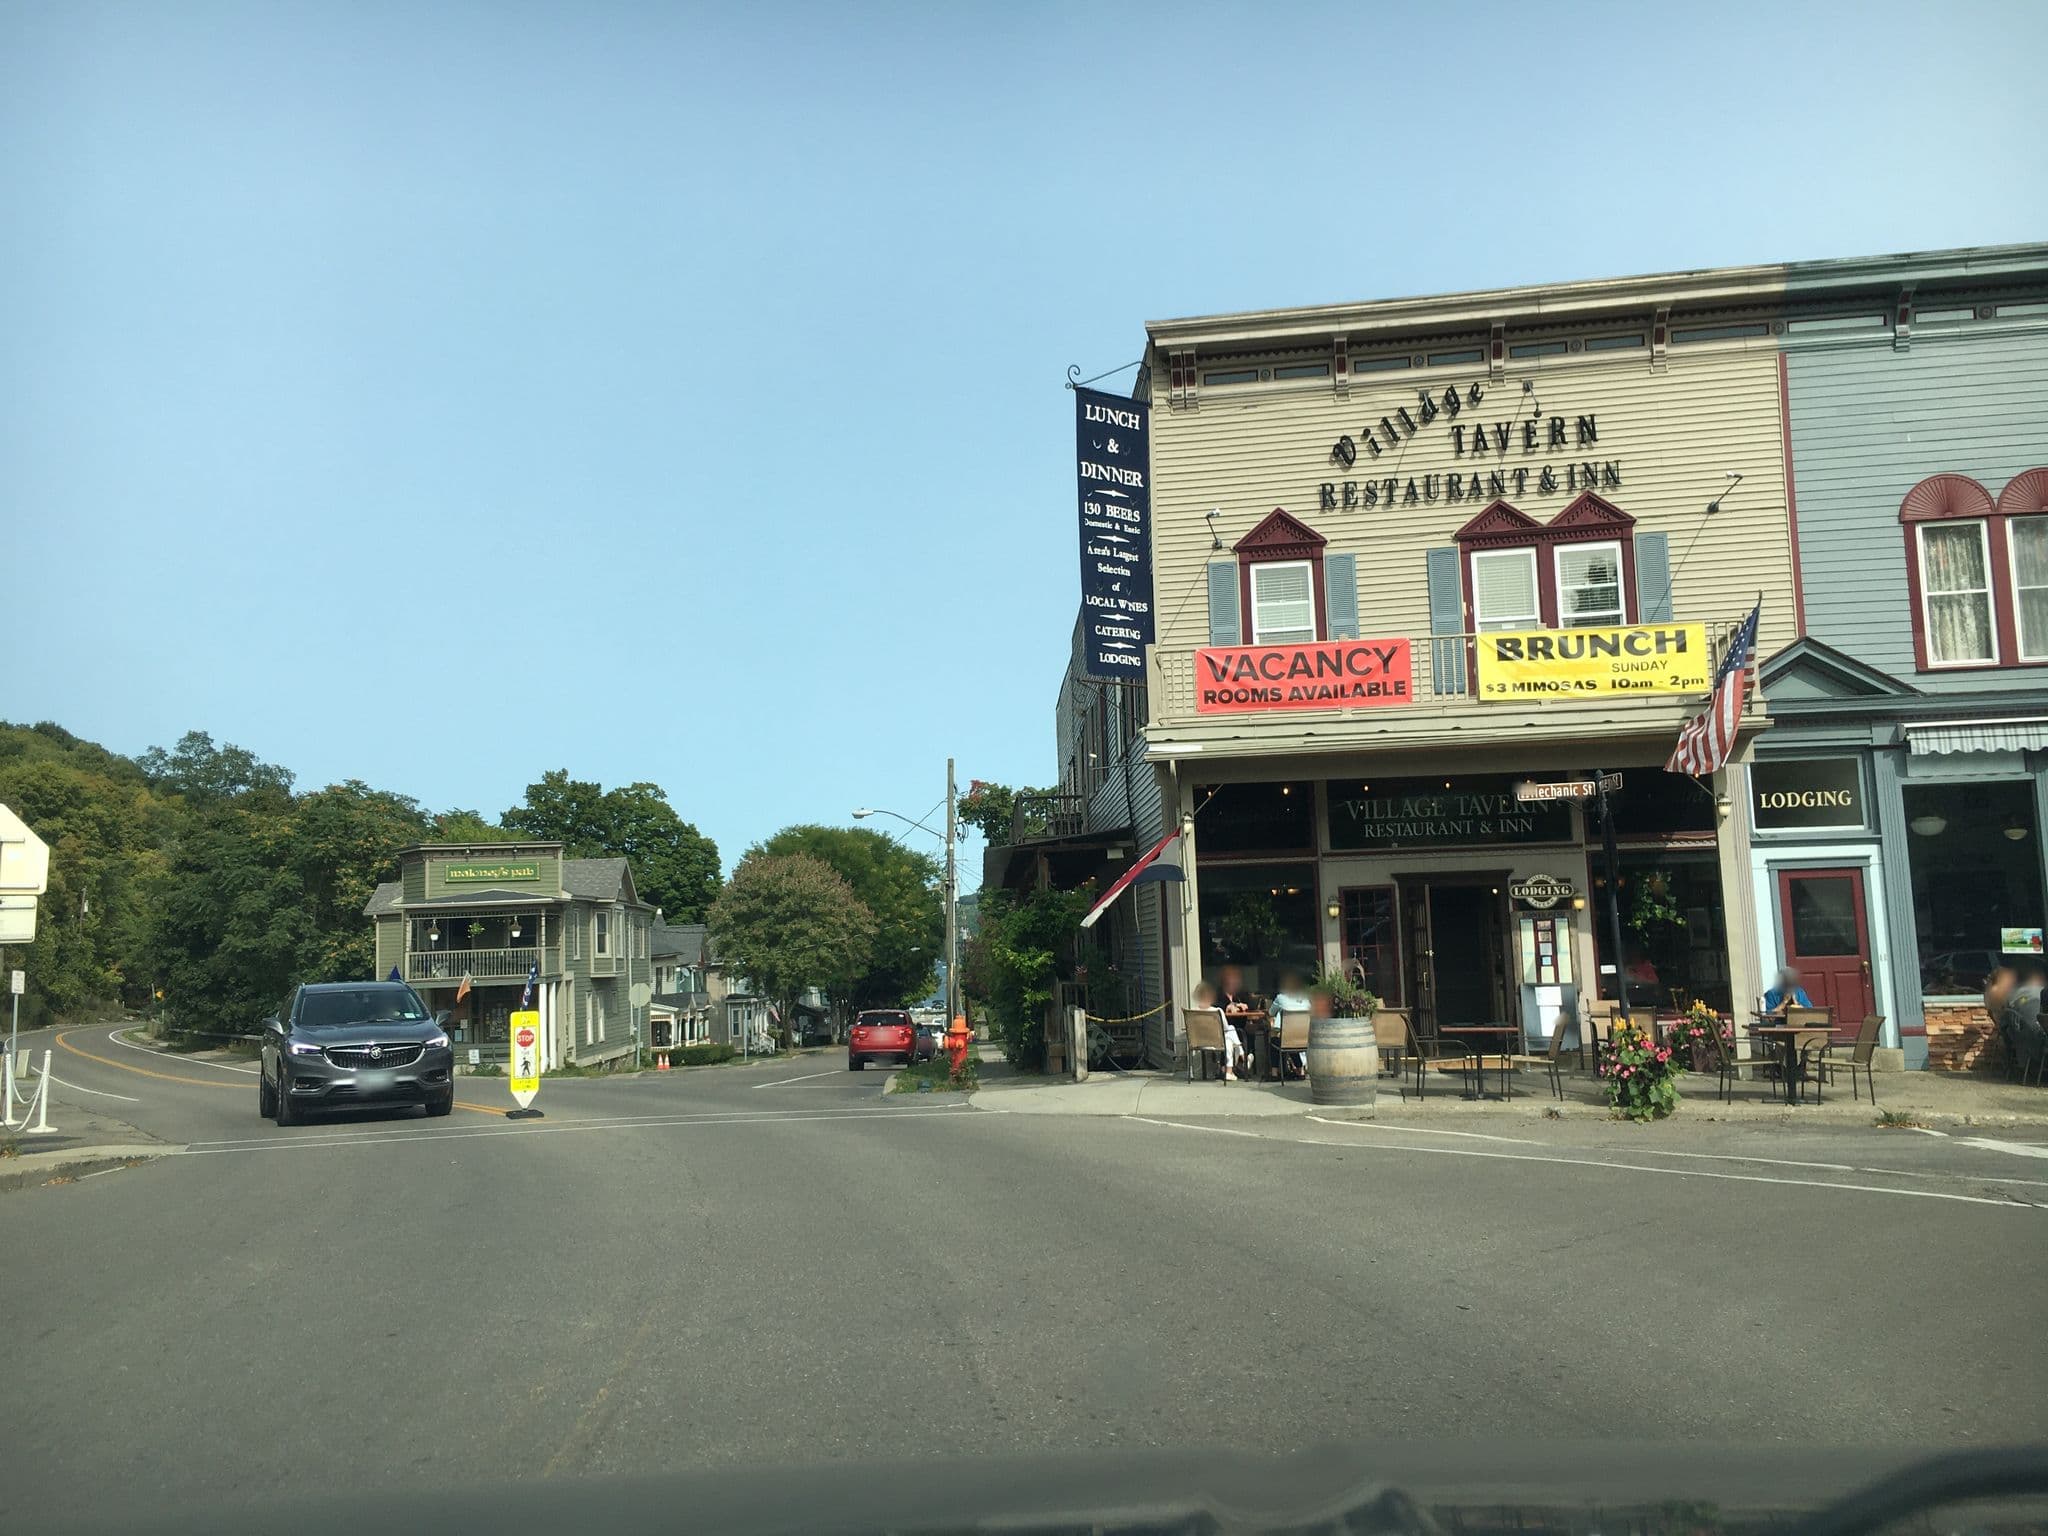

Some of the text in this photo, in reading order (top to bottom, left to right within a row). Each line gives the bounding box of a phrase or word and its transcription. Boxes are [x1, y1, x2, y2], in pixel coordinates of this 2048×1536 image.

[1085, 404, 1140, 430] LUNCH
[1333, 382, 1484, 465] Village
[1451, 414, 1599, 454] TAVERN
[1107, 438, 1119, 453] &
[1080, 461, 1144, 487] DINNER
[1320, 459, 1622, 508] RESTAURANT & INN
[1084, 501, 1141, 522] 130 BEERS
[1113, 547, 1139, 562] Largest
[1097, 562, 1131, 577] Selection
[1112, 582, 1121, 592] of
[1085, 594, 1117, 608] LOCAL
[1095, 625, 1141, 640] CATERING
[1496, 629, 1687, 662] BRUNCH
[1099, 652, 1141, 667] LODGING
[1205, 646, 1399, 682] VACANCY
[1612, 660, 1668, 673] SUNDAY
[1203, 680, 1406, 704] ROOMS AVAILABLE
[1512, 680, 1598, 692] MIMOSAS
[1611, 678, 1653, 689] 10am
[1670, 676, 1704, 688] 2pm
[1582, 783, 1593, 796] St
[1345, 793, 1550, 820] VILLAGE TAVERN
[1760, 790, 1852, 808] LODGING
[1364, 818, 1534, 838] RESTAURANT & INN
[1514, 886, 1569, 896] LODGING
[517, 1034, 534, 1042] STOP
